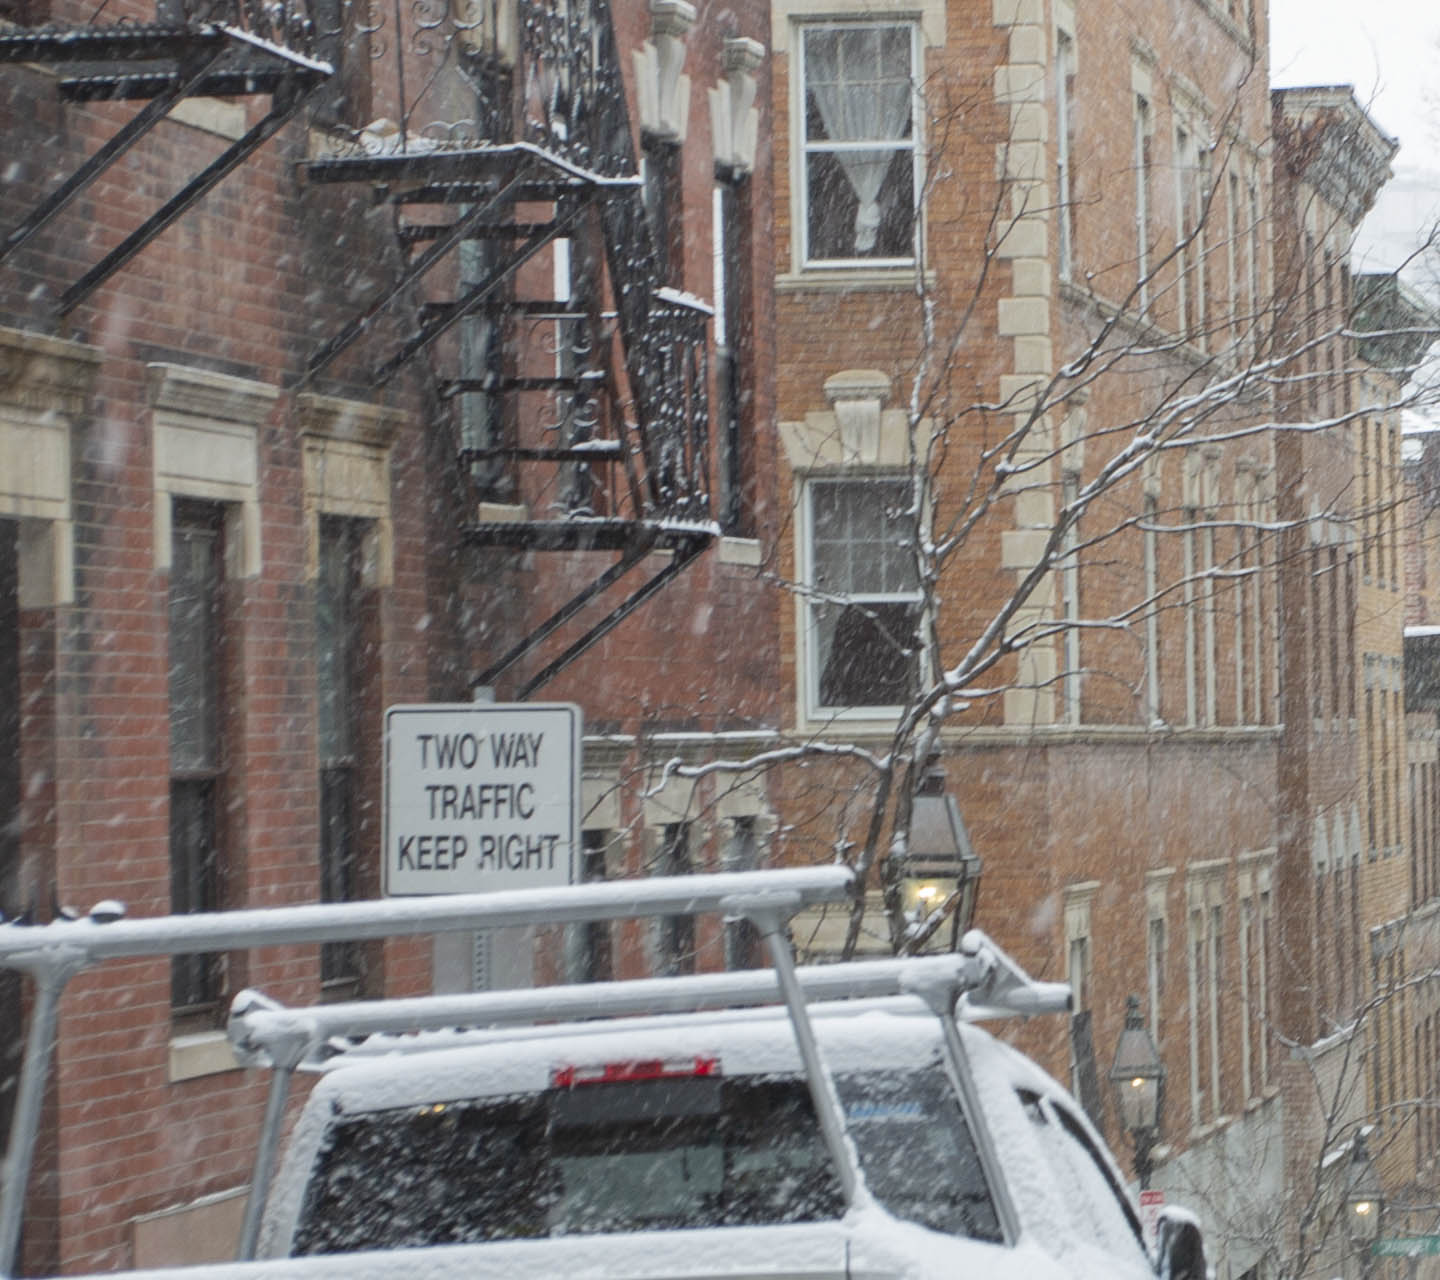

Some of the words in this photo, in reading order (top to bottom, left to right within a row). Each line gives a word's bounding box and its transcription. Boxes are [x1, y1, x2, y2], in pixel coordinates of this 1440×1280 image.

[417, 732, 479, 770] TWO
[490, 732, 544, 769] WAY
[425, 783, 535, 820] TRAFFIC
[397, 835, 468, 870] KEEP
[478, 834, 560, 870] RIGHT
